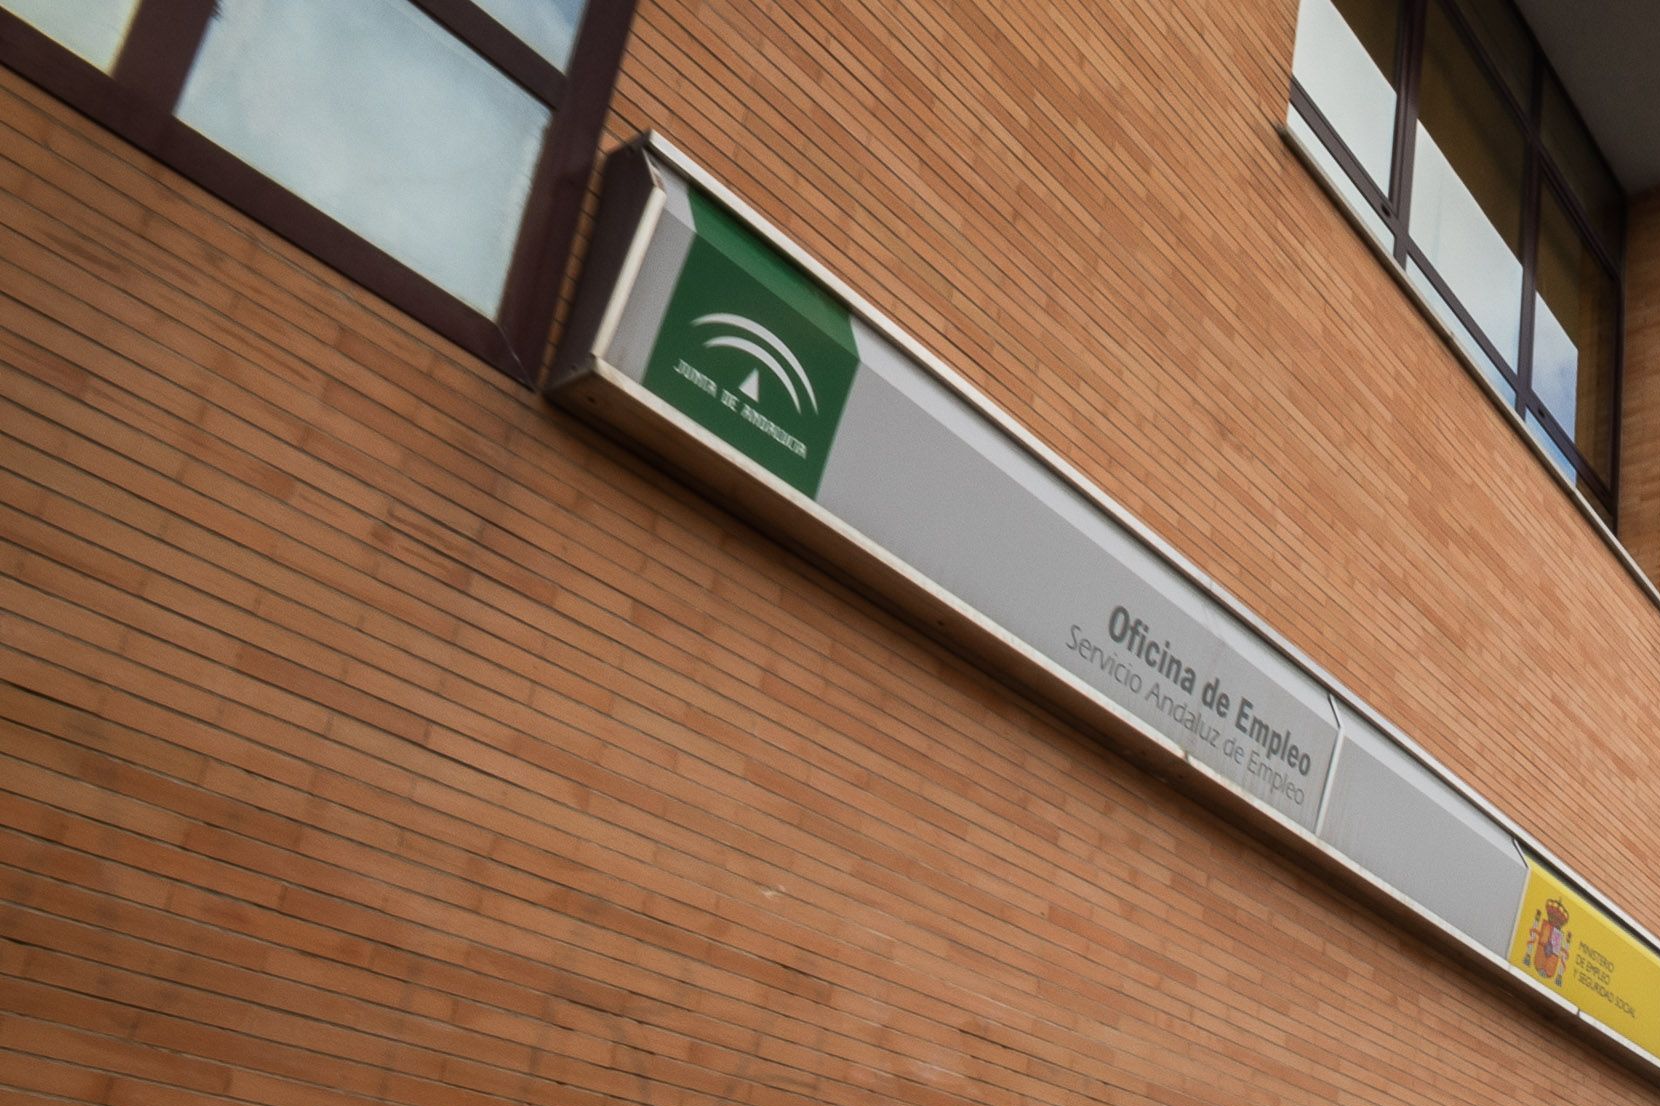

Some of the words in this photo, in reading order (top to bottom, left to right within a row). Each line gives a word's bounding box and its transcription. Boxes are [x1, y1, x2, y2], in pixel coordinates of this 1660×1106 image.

[673, 358, 717, 398] JUNTA
[720, 388, 740, 412] DE
[1108, 605, 1196, 696] Oficina
[1202, 678, 1231, 718] de
[1235, 696, 1312, 776] Empleo
[1065, 624, 1142, 694] Servicio
[1145, 683, 1220, 748] Andaluz
[1223, 737, 1245, 765] de
[1246, 749, 1305, 805] Empleo
[1575, 953, 1586, 969] DE
[1586, 961, 1610, 985] EMPLEO
[1579, 941, 1615, 973] MINISTERIO
[1579, 971, 1615, 1003] SEGURIDAD
